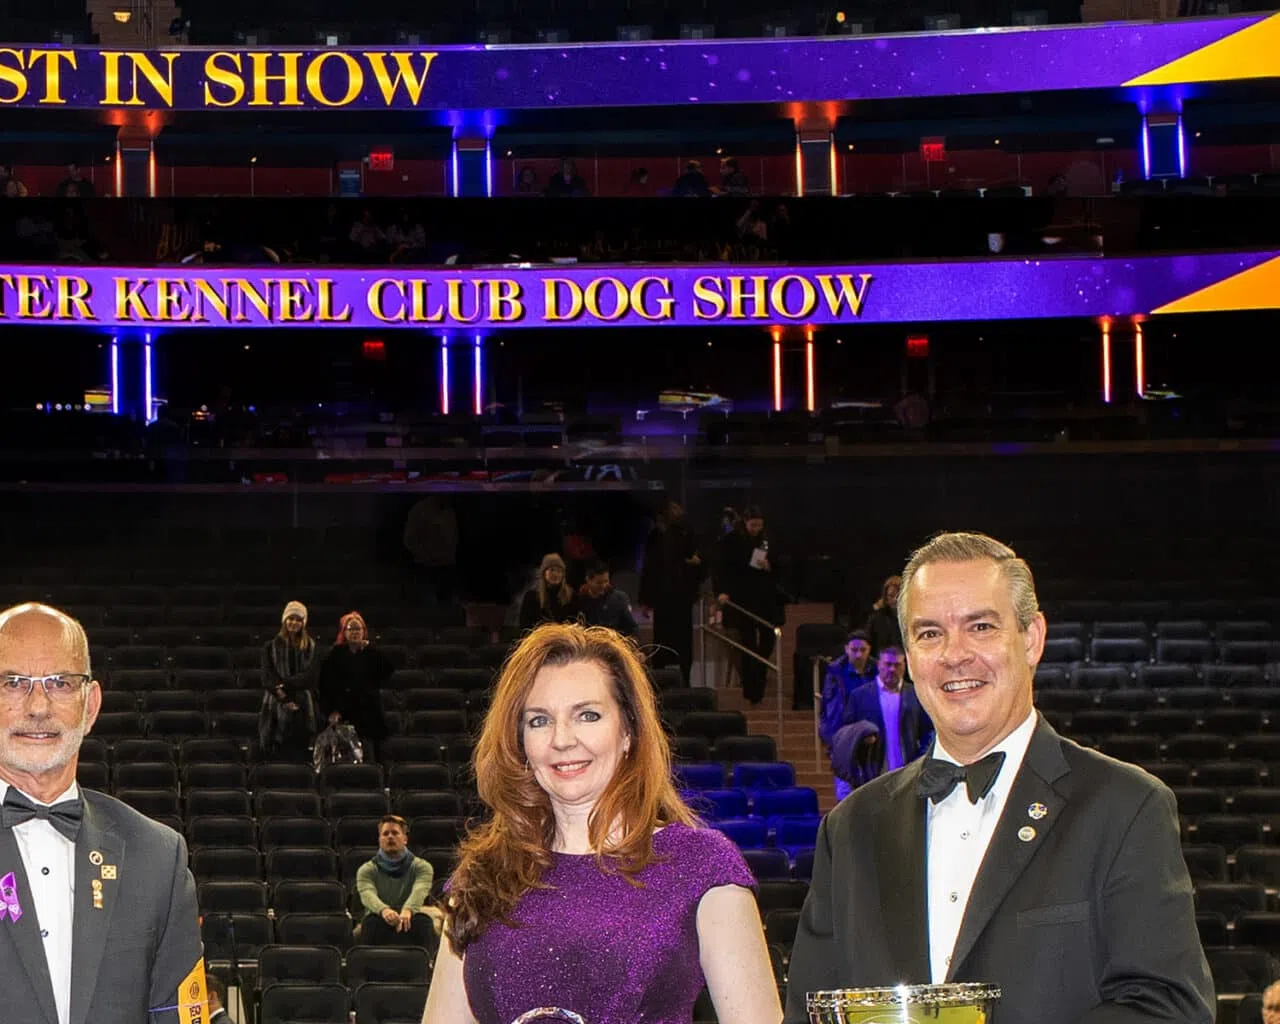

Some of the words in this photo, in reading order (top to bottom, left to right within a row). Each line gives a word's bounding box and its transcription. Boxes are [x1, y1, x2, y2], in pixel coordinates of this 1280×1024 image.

[99, 51, 181, 107] IN
[204, 51, 438, 107] SHOW
[113, 278, 352, 323] KENNEL
[365, 279, 525, 323] CLUB
[542, 277, 676, 322] DOG
[692, 273, 872, 321] SHOW
